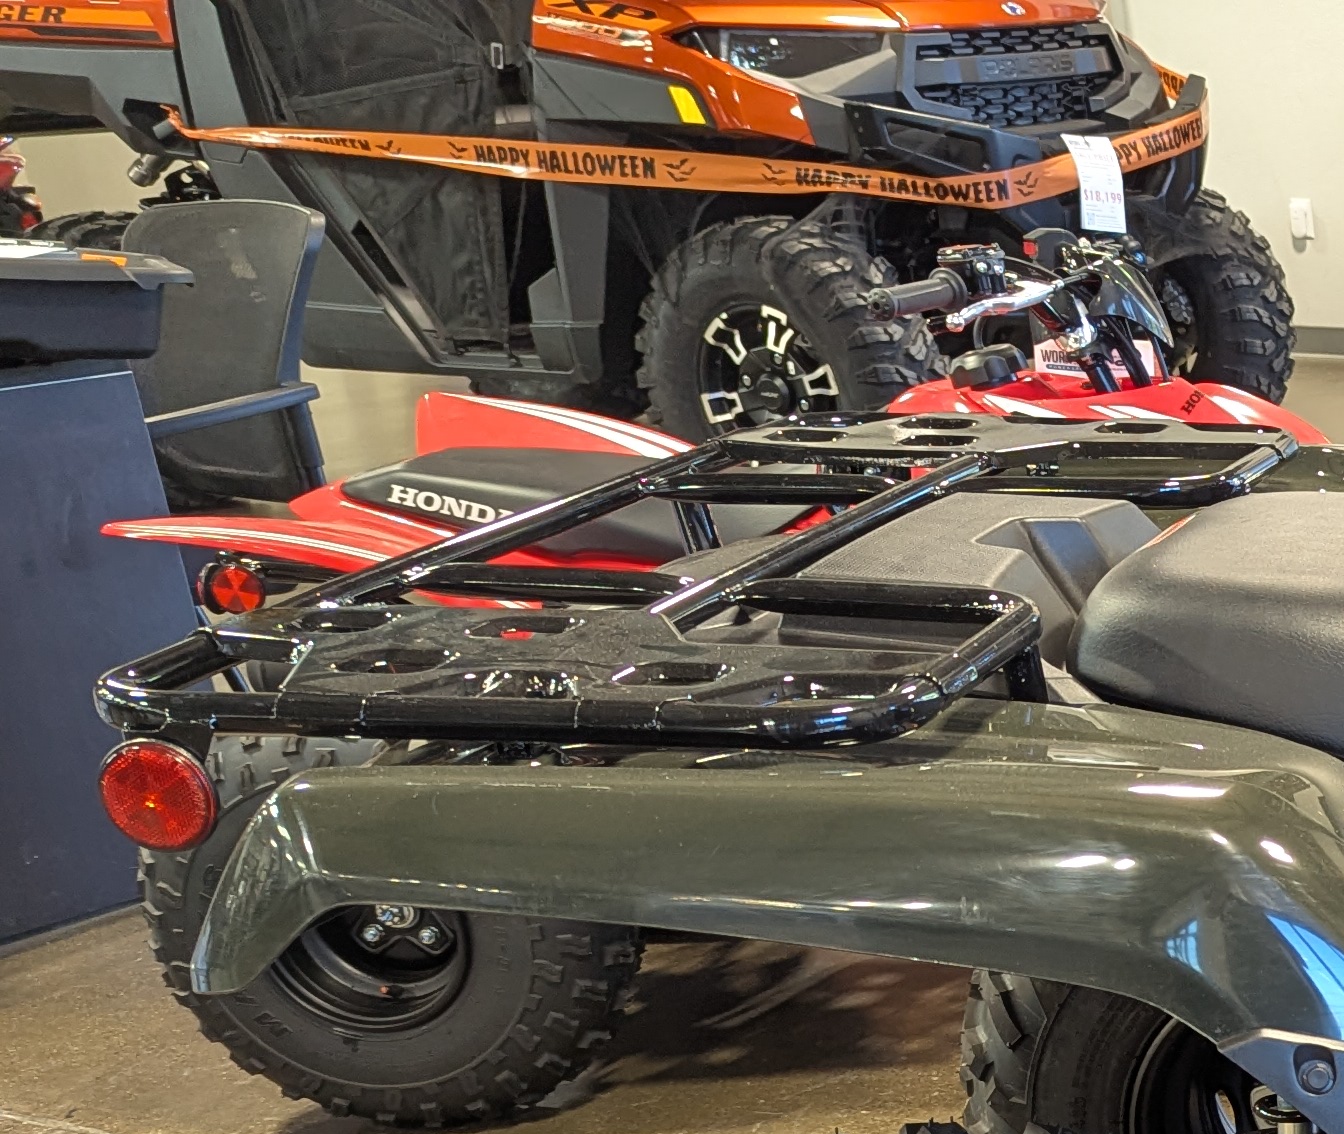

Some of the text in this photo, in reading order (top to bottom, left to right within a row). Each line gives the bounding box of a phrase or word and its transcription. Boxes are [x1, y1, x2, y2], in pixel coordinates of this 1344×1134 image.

[1114, 118, 1203, 166] PPY HALLOWEE
[473, 145, 657, 180] HAPPY HALLOWEEN
[795, 167, 1010, 203] HAPPY HALLOWEEN
[1084, 189, 1122, 204] $18,199
